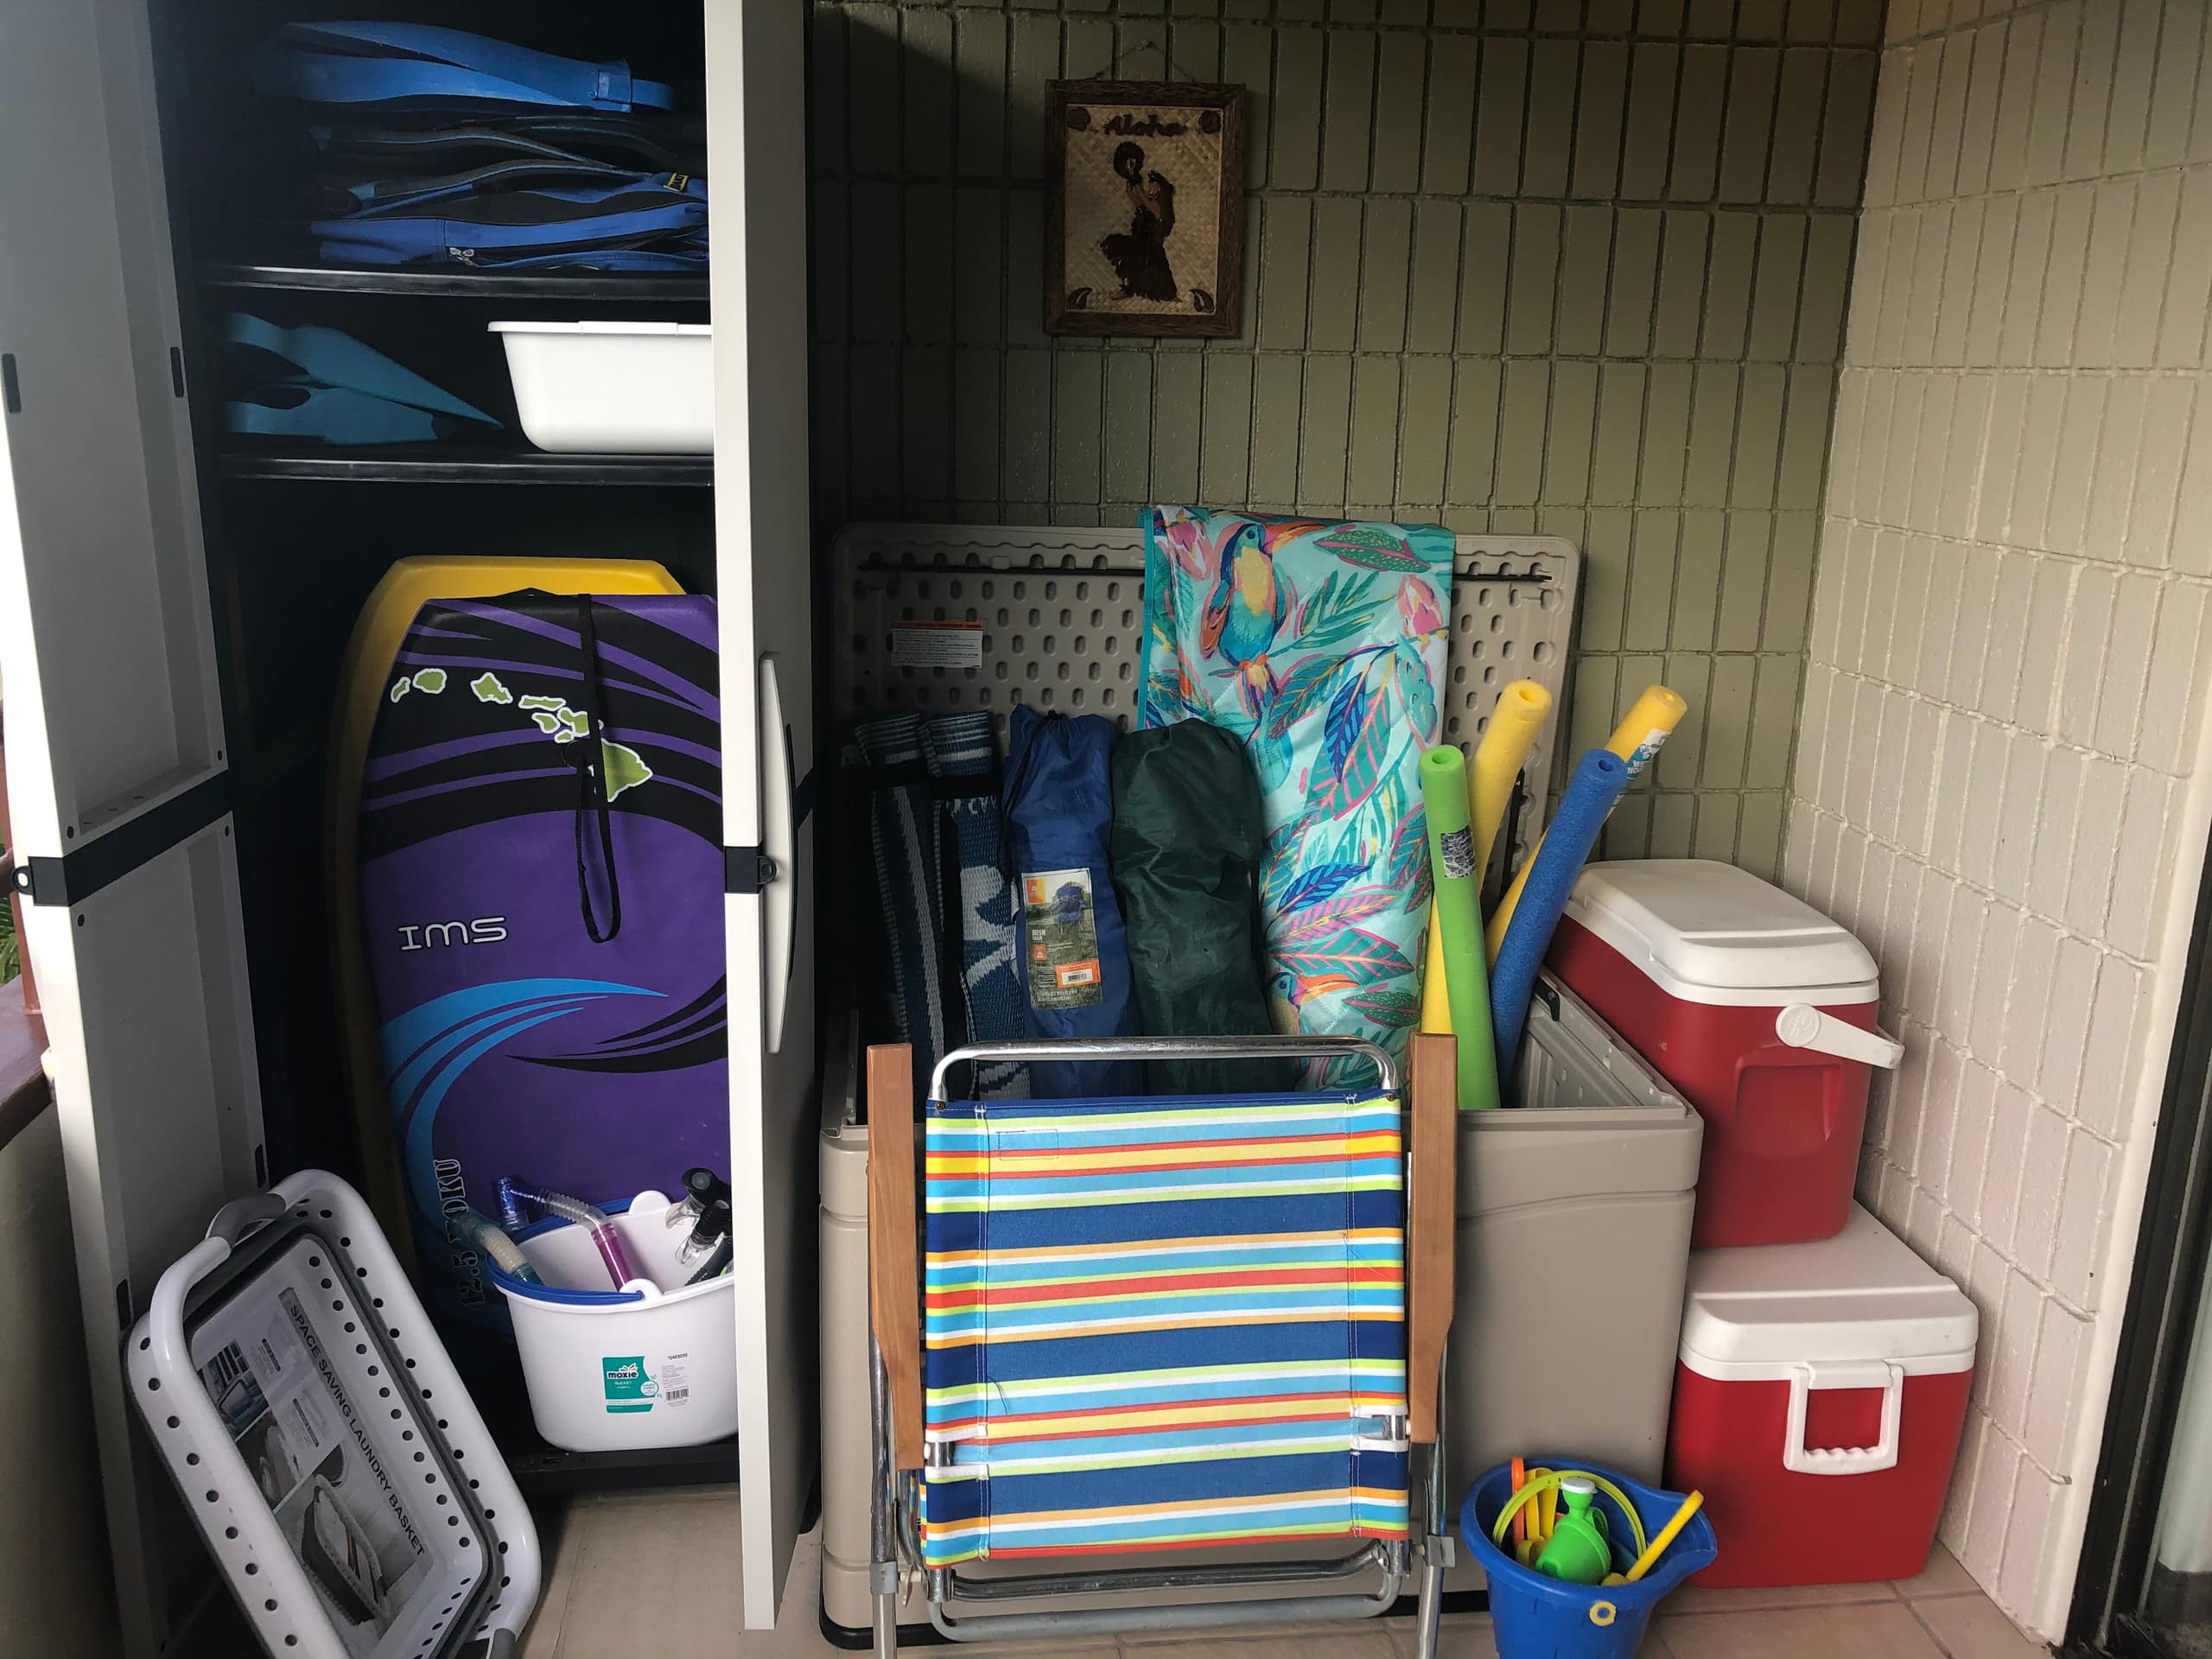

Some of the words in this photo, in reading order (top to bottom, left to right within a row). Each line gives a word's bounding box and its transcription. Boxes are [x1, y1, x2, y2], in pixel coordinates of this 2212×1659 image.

[1103, 113, 1188, 138] Aloha
[397, 916, 507, 950] IMS
[433, 1158, 469, 1244] OKU
[289, 1304, 322, 1359] SPACE
[318, 1358, 353, 1418] SAVING
[349, 1418, 392, 1492] LAUNDRY
[388, 1493, 425, 1556] BASKET
